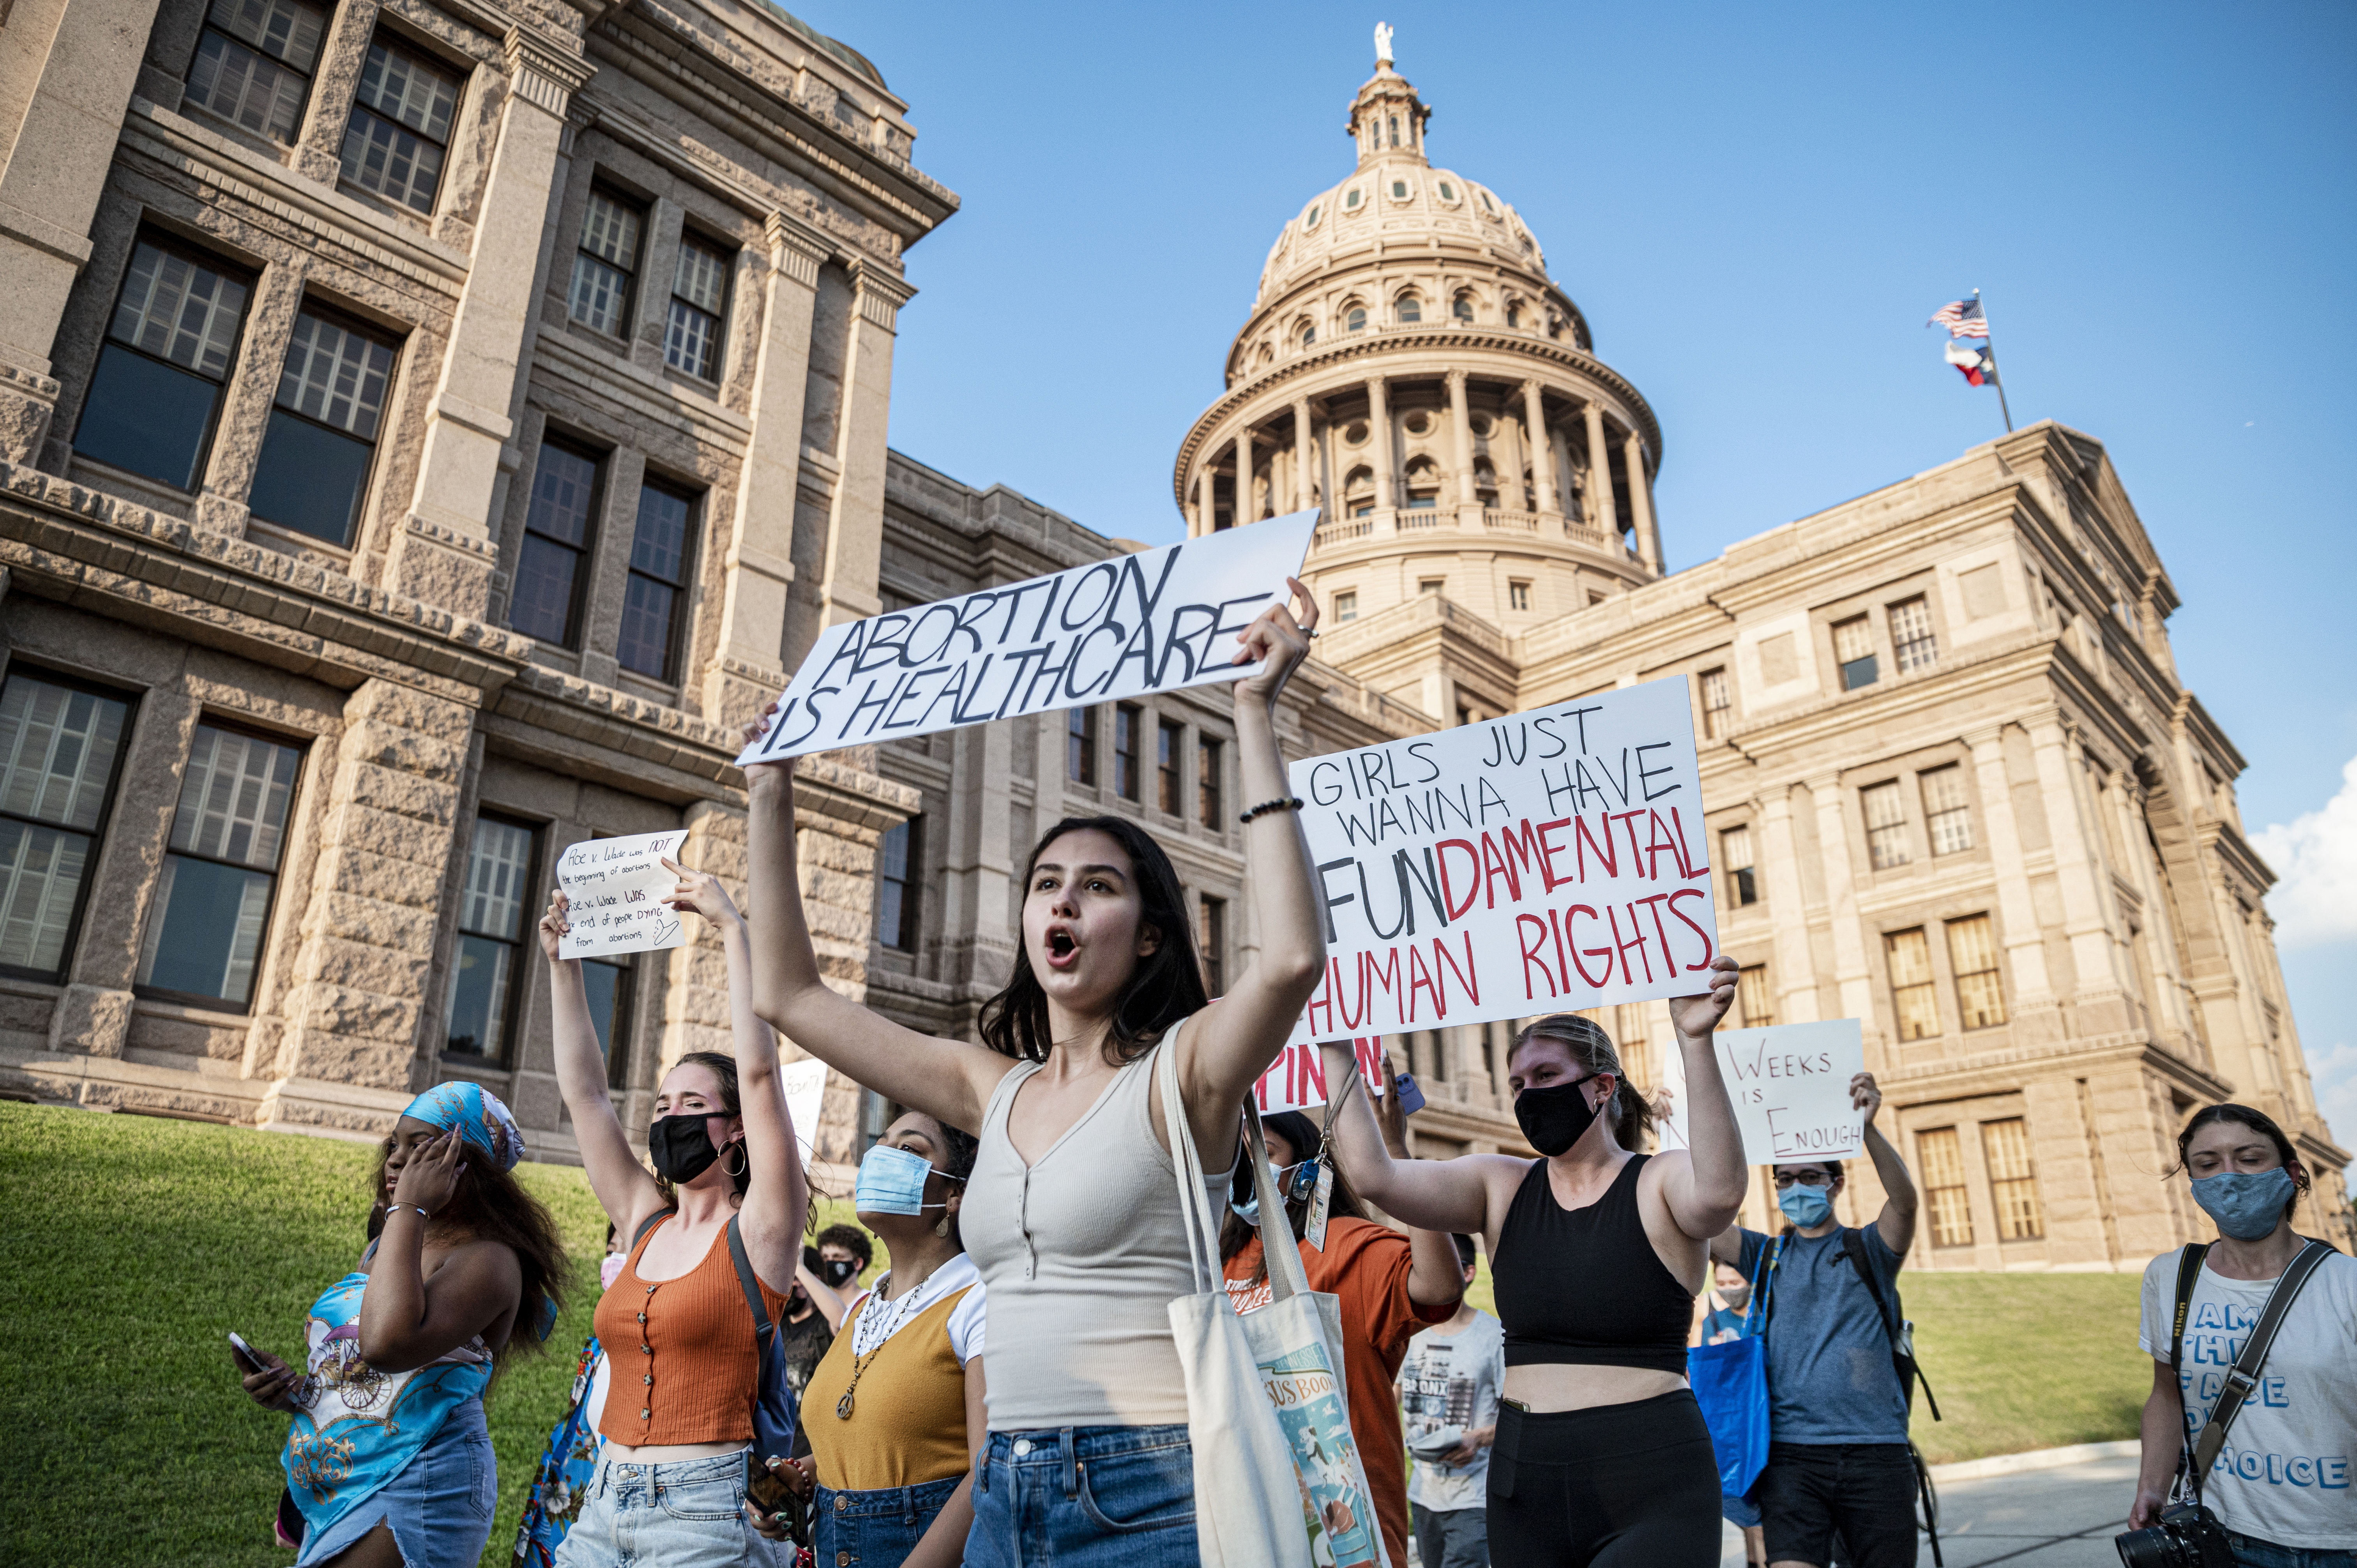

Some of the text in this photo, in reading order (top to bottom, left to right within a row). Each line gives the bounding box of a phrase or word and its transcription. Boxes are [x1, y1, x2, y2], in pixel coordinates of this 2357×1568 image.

[812, 545, 1183, 690] ABORTION
[761, 592, 1274, 755] IS HEALTHCARE
[1310, 706, 1603, 806] GIRLS JUST
[1336, 742, 1682, 847] WANNA HAVE
[568, 849, 586, 866] Roe
[604, 846, 625, 861] Wade
[562, 863, 650, 886] the beginning of abortions
[1317, 807, 1710, 944] FUNDAMENTAL
[596, 895, 618, 907] Wade
[624, 889, 645, 904] WAS
[580, 915, 595, 928] end
[602, 913, 611, 926] of
[614, 913, 633, 928] people
[576, 931, 642, 947] from abortions
[1308, 889, 1712, 1036] HUMAN RIGHTS
[1742, 1089, 1763, 1105] IS
[1767, 1107, 1861, 1154] ENOUGH
[2175, 1302, 2186, 1337] Nikon
[2194, 1303, 2260, 1330] AM
